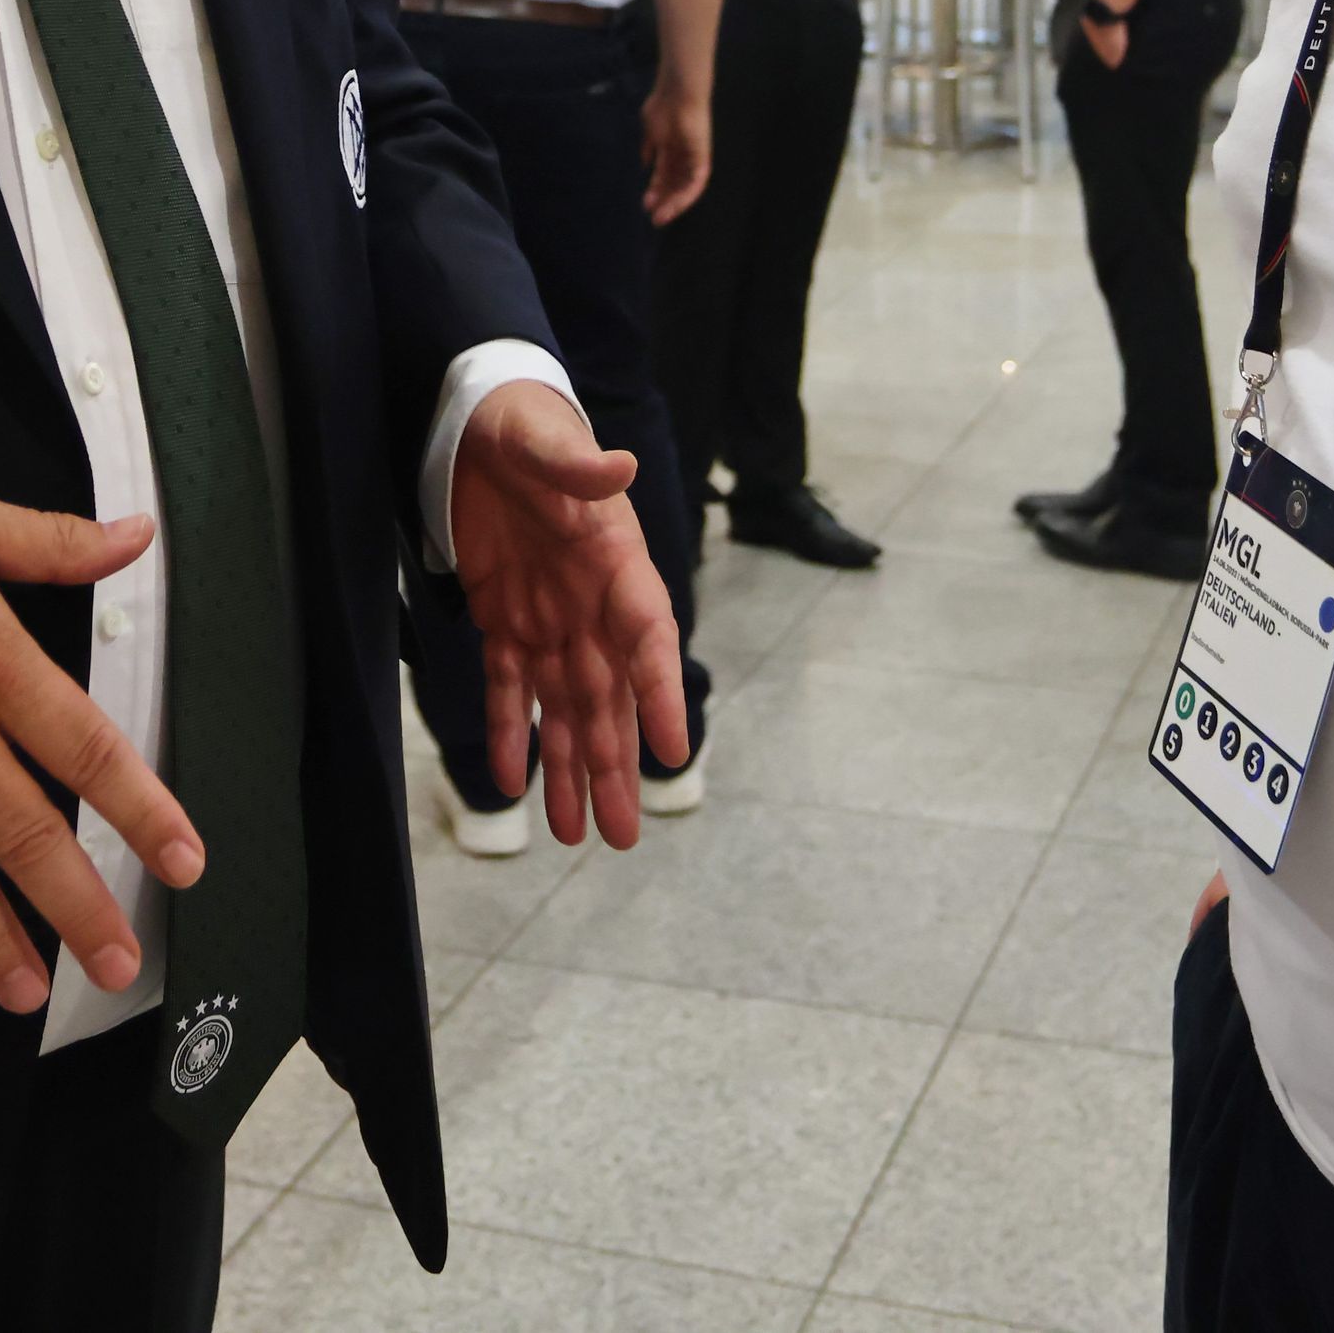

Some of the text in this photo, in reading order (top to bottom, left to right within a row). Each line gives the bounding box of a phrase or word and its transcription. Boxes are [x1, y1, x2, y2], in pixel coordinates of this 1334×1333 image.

[1216, 517, 1262, 580] MGL
[1200, 589, 1238, 629] ITALIEN
[1205, 570, 1277, 637] DEUTSCHLAND
[1165, 730, 1178, 754] 5
[1200, 710, 1212, 735] 1
[1223, 729, 1236, 755] 2
[1247, 749, 1260, 776] 3
[1271, 773, 1284, 798] 4
